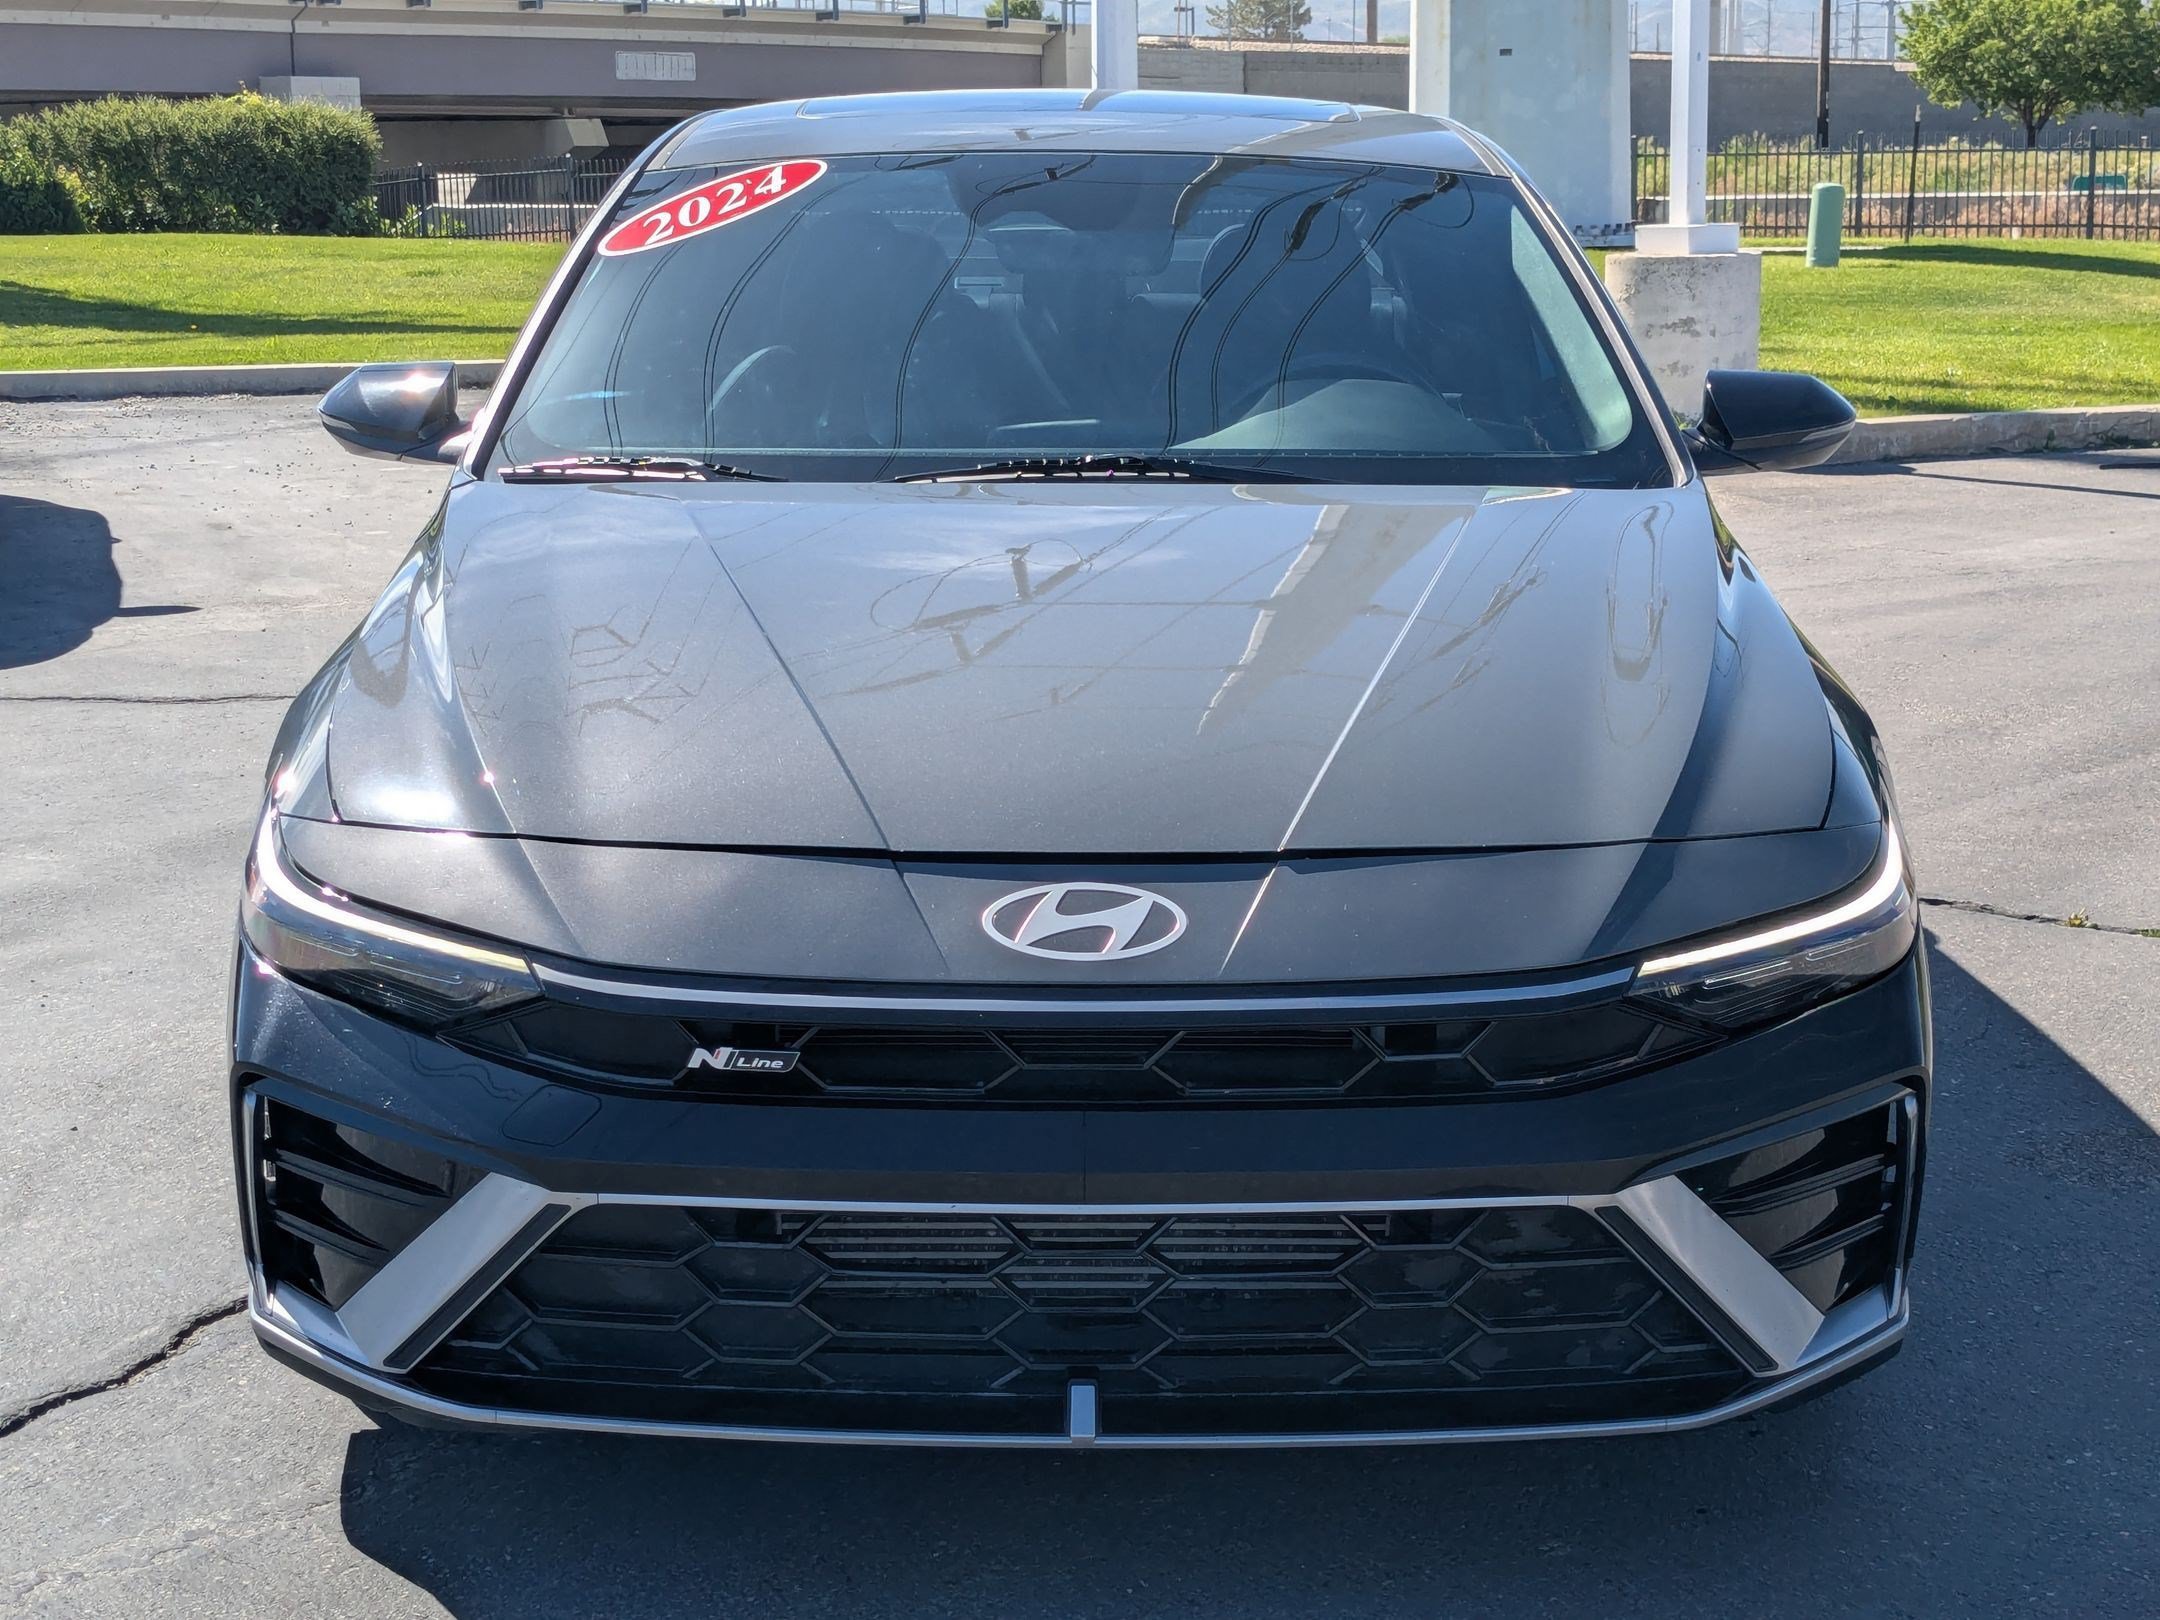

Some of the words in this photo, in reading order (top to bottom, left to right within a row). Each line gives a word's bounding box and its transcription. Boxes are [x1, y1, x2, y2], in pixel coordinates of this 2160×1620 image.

[643, 164, 787, 246] 2024
[687, 1046, 734, 1070] N
[736, 1057, 784, 1069] Line
